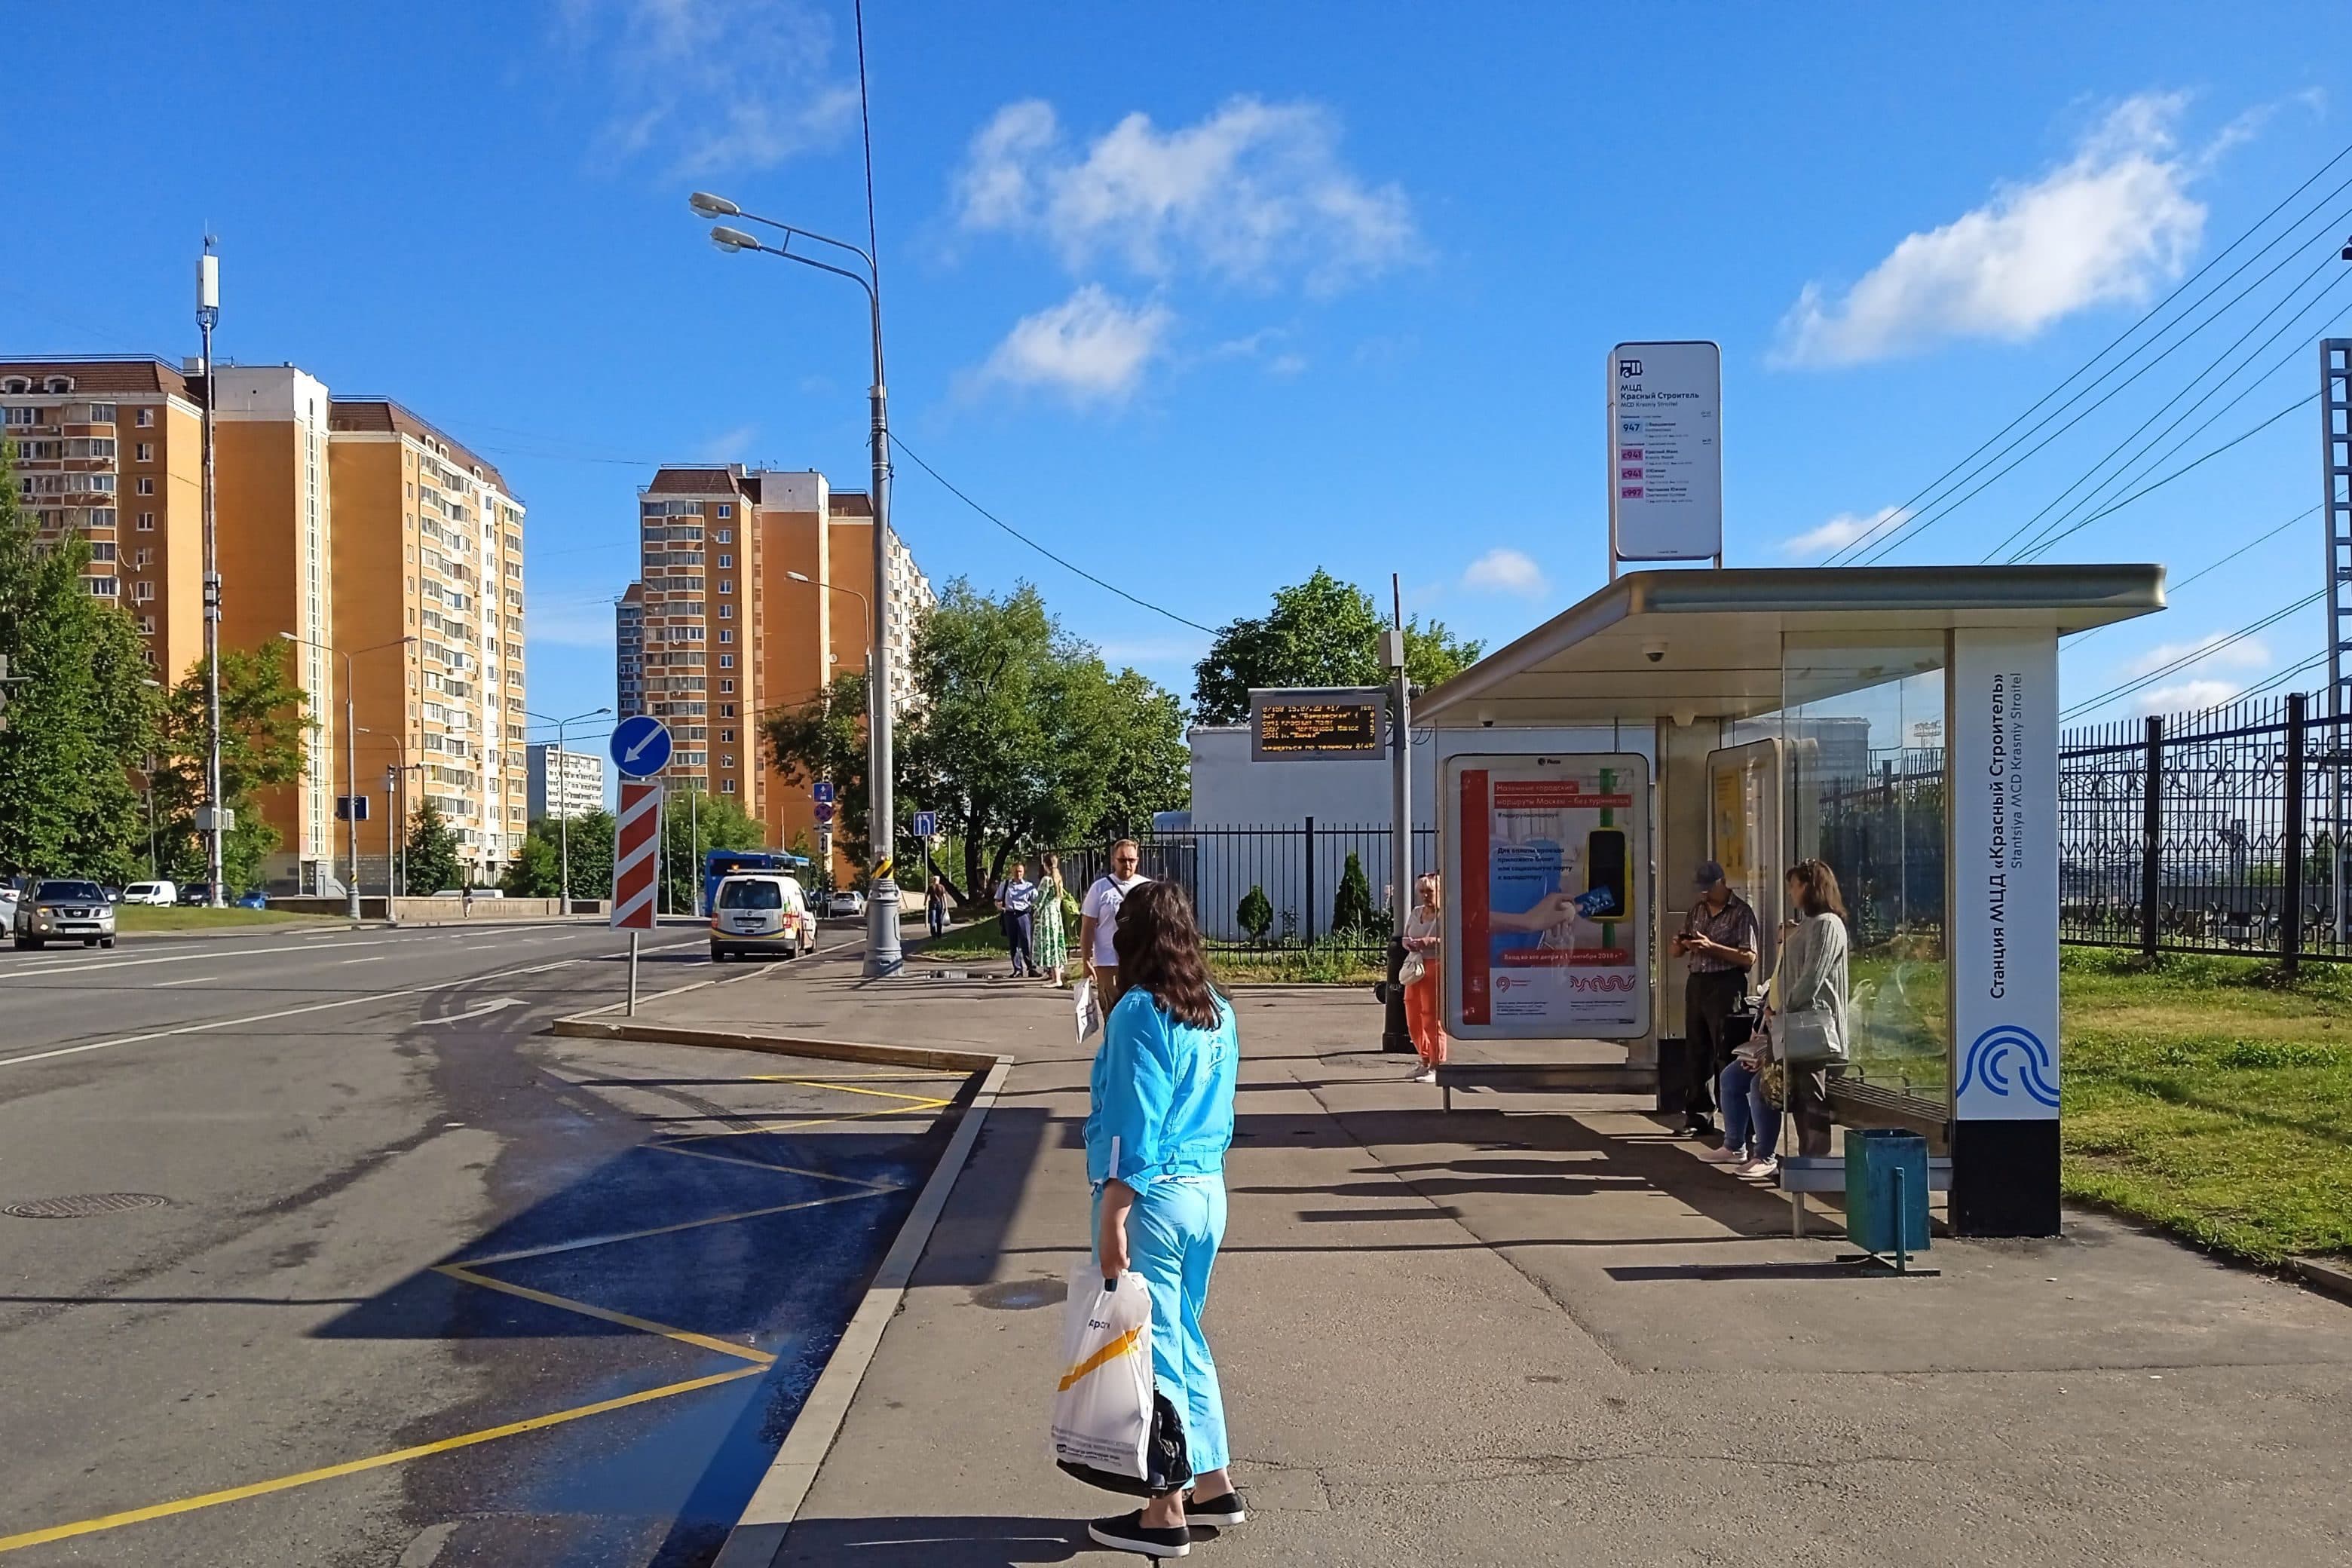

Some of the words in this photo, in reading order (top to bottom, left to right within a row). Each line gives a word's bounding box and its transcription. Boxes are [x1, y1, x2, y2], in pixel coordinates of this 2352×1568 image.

[1620, 384, 1642, 392] МЦД
[1621, 392, 1655, 400] Красный
[1657, 392, 1699, 400] Строитель
[1623, 423, 1640, 432] 947
[2010, 673, 2022, 719] Stroitel
[1989, 674, 2007, 776] Строитель»
[2011, 722, 2024, 770] Krasniy
[2011, 773, 2023, 807] MCD
[1989, 782, 2007, 869] «Красный
[2011, 811, 2025, 869] Stantsiya
[1989, 874, 2007, 923] МЦД
[1989, 927, 2007, 1000] Станция
